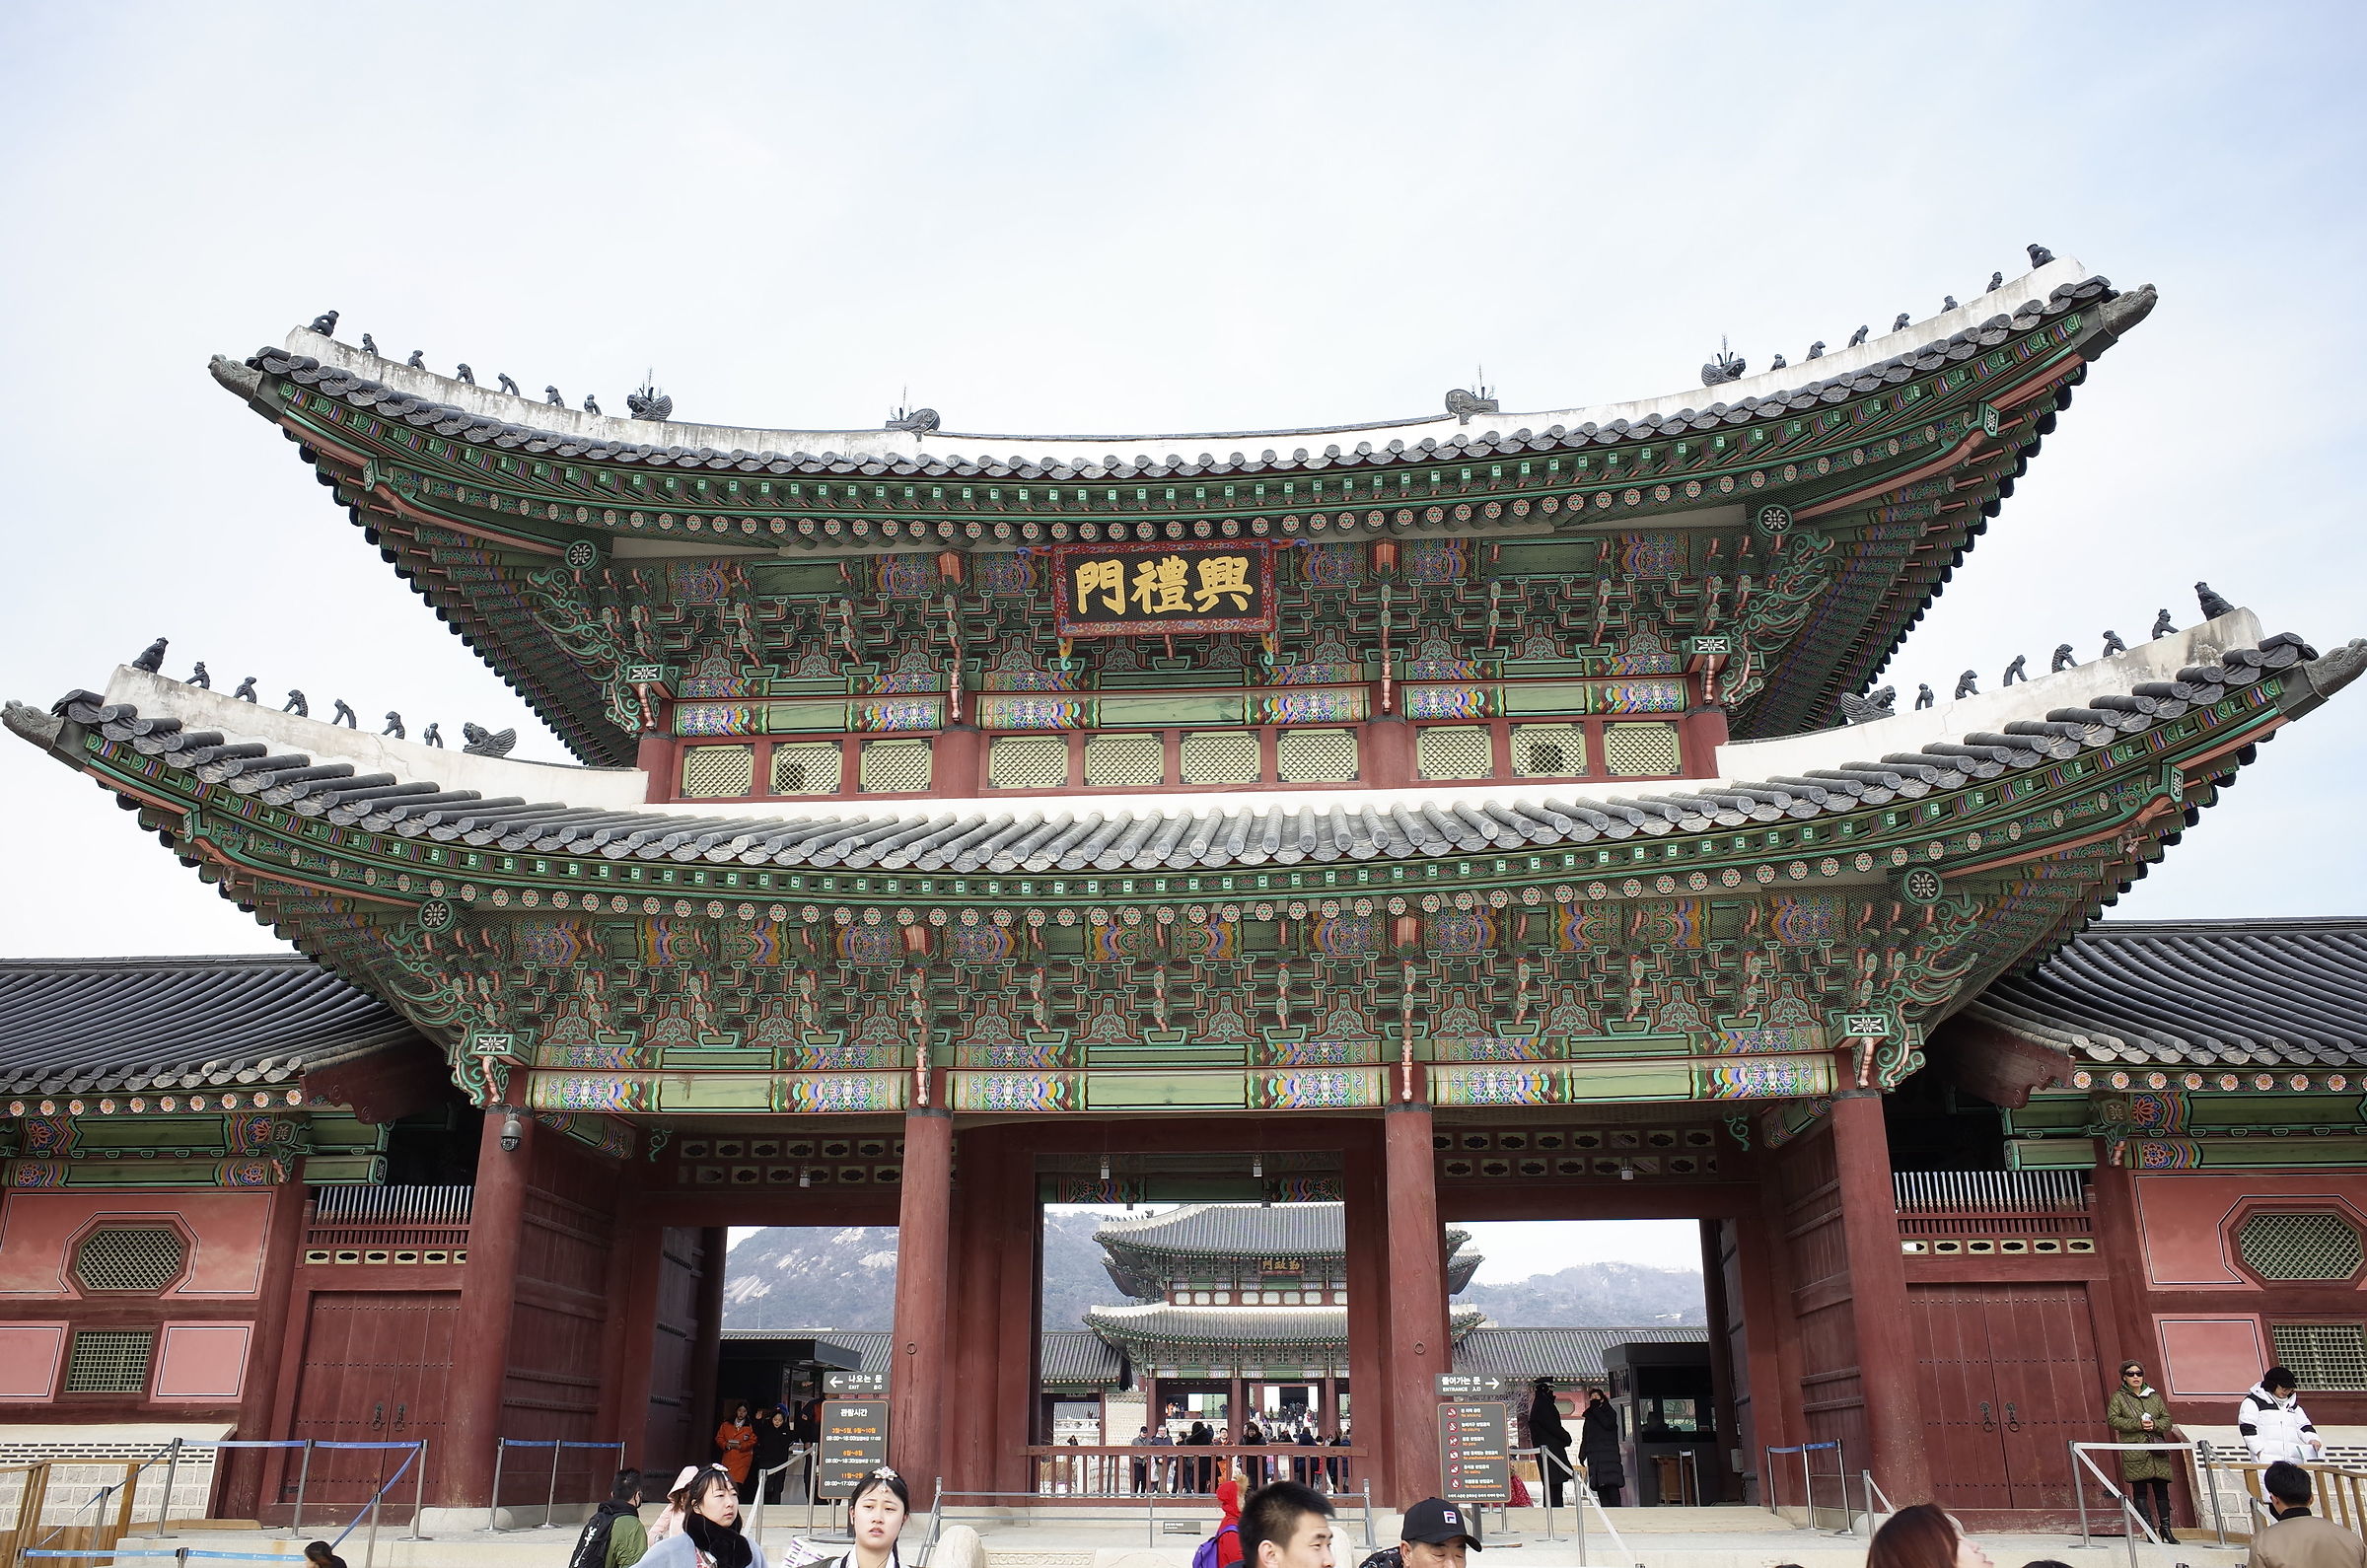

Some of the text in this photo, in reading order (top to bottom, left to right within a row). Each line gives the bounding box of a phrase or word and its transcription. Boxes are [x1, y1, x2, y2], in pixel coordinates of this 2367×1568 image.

[848, 1374, 883, 1384] 나오는 문
[1442, 1376, 1481, 1386] 들어가는 문
[840, 1408, 868, 1417] 관람시간
